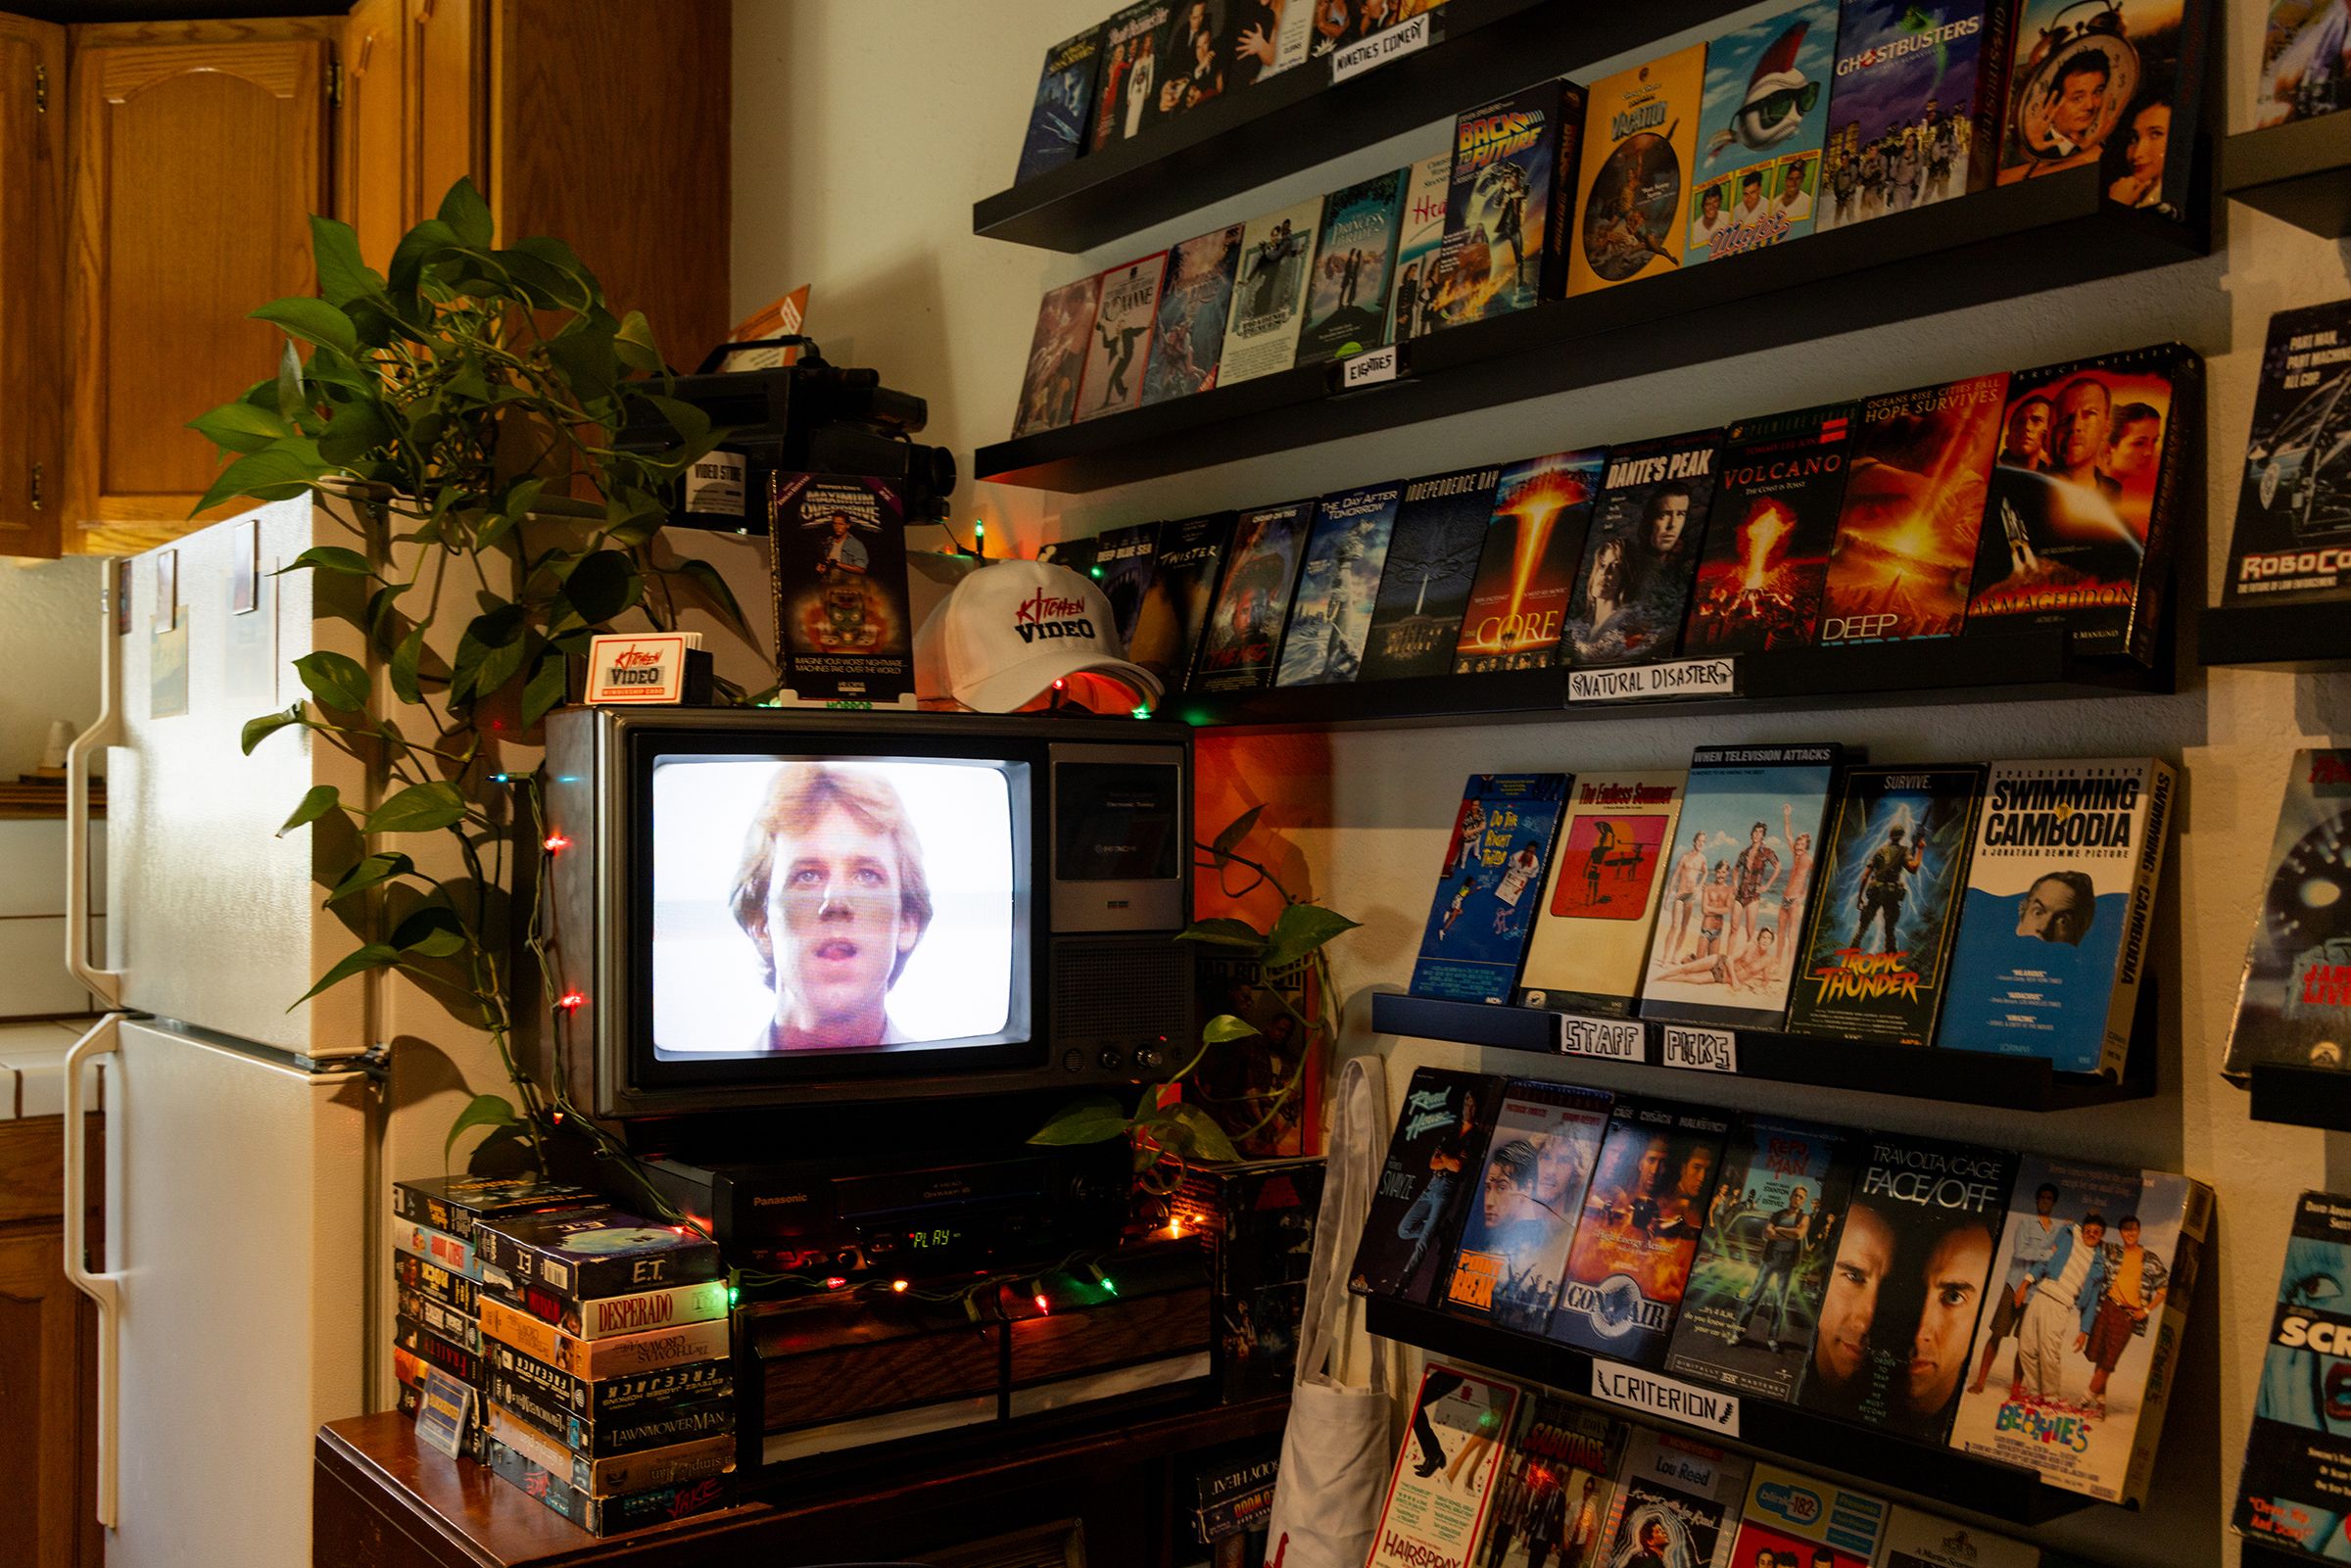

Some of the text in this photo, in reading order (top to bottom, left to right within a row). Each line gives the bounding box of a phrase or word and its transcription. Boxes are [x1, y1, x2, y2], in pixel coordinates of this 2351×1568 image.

[1336, 42, 1379, 71] NINETIES
[1458, 111, 1532, 152] BACK
[1350, 355, 1393, 380] EIGHTIES
[1865, 404, 1910, 423] HOPE
[1605, 449, 1715, 490] DANTE'S PEAK
[1723, 453, 1843, 491] VOLCANO
[804, 491, 876, 505] MAXIMUM
[1362, 490, 1399, 504] AFTER
[1405, 469, 1501, 502] INDEPENDENCE DAY
[1328, 501, 1385, 521] TOMORROW
[1160, 545, 1218, 565] TWISTER
[2239, 549, 2351, 582] ROBOCO
[1973, 587, 2137, 615] ARMAGEDDON
[1015, 618, 1095, 643] VIDEO
[1475, 610, 1559, 646] CORE
[1822, 612, 1898, 641] DEEP
[611, 668, 659, 685] VIDEO
[1694, 747, 1831, 763] WHEN TELEVISION ATTACKS
[1579, 783, 1595, 805] The
[1595, 784, 1634, 806] Endless
[1991, 777, 2140, 812] SWIMMING
[1985, 812, 2131, 848] CAMBODIA
[2119, 770, 2172, 985] SWIMMING CAMBODIA
[1834, 946, 1909, 976] TROPIC
[1814, 966, 1920, 1006] THUNDER
[1565, 1021, 1730, 1070] STAFF PICKS
[753, 1193, 808, 1207] Panasonic
[1862, 1166, 1999, 1213] FACE/OFF
[599, 1293, 673, 1333] DESPERADO
[638, 1334, 686, 1352] CROWN
[2278, 1315, 2351, 1358] SCR
[638, 1343, 695, 1364] THOMAS
[604, 1367, 717, 1400] FREEJACK
[1613, 1374, 1716, 1420] CRITERION
[1678, 1463, 1711, 1487] Reed
